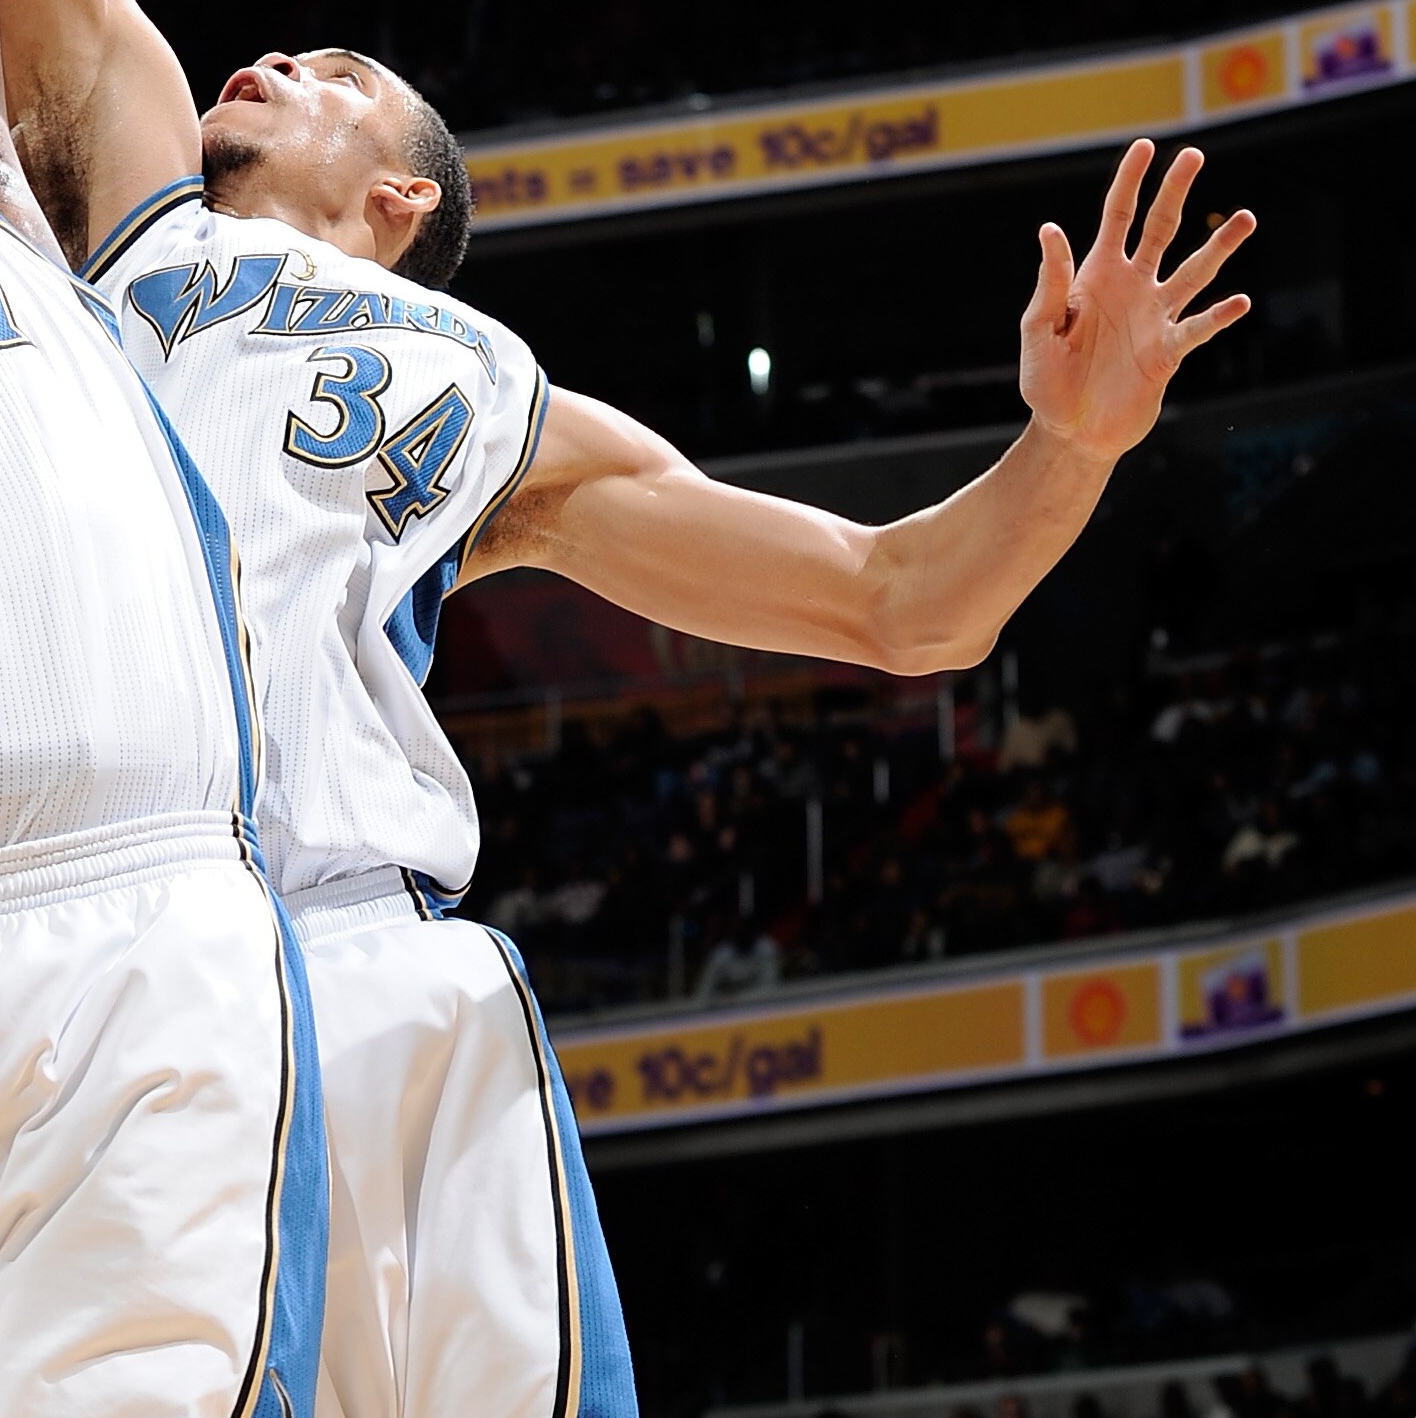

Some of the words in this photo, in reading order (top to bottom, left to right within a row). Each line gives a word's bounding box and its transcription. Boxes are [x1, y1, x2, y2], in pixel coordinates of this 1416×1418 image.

[618, 144, 736, 193] save
[760, 104, 939, 167] 10c/gal
[282, 344, 475, 543] 34
[568, 1065, 614, 1111] ve
[639, 1024, 822, 1099] 10c/gal
